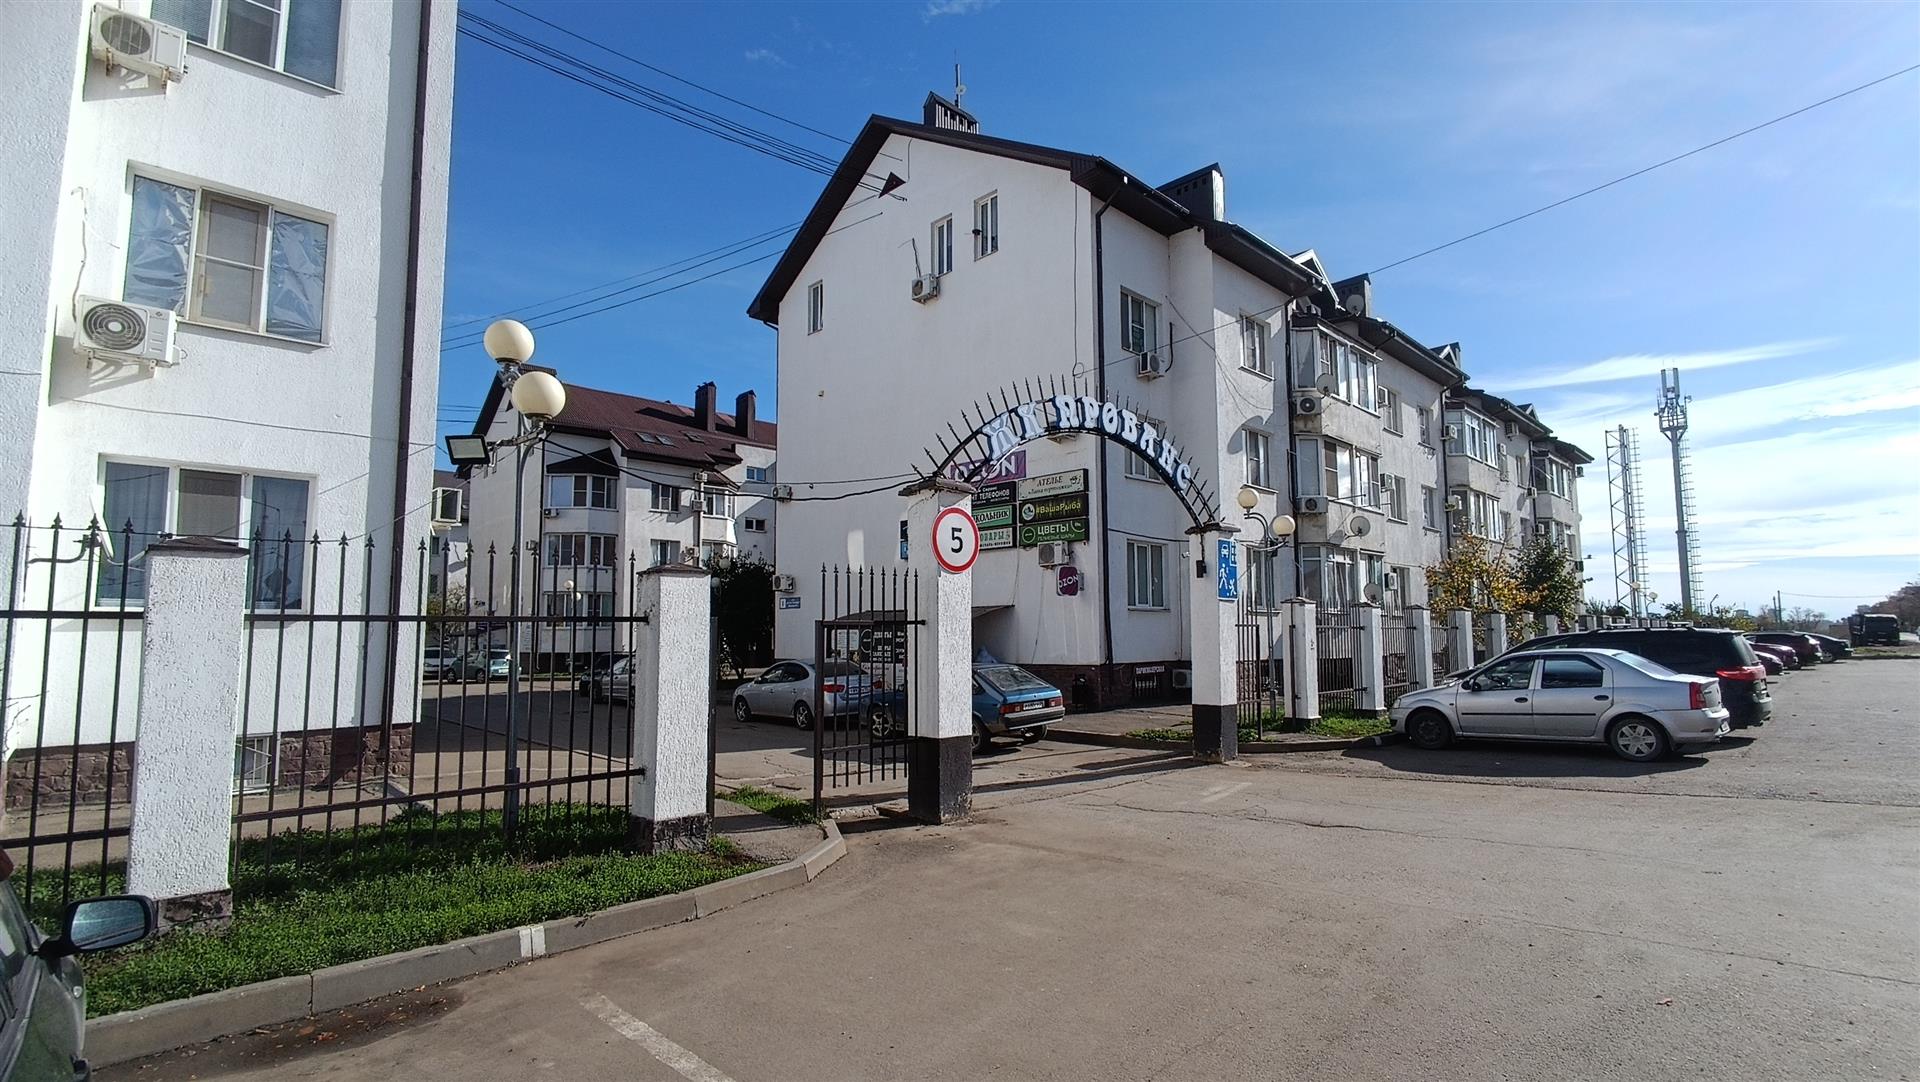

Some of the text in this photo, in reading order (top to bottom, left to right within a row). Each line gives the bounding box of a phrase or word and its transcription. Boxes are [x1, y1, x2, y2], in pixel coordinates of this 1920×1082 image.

[982, 394, 1192, 490] ЖК ПРОВАНС
[1037, 475, 1064, 487] АТЕЛЬЕ
[980, 489, 1010, 500] ТЕЛЕФОНОВ
[1037, 523, 1069, 535] ЦВЕТЫ
[951, 527, 963, 553] 5
[1059, 575, 1078, 588] OZON
